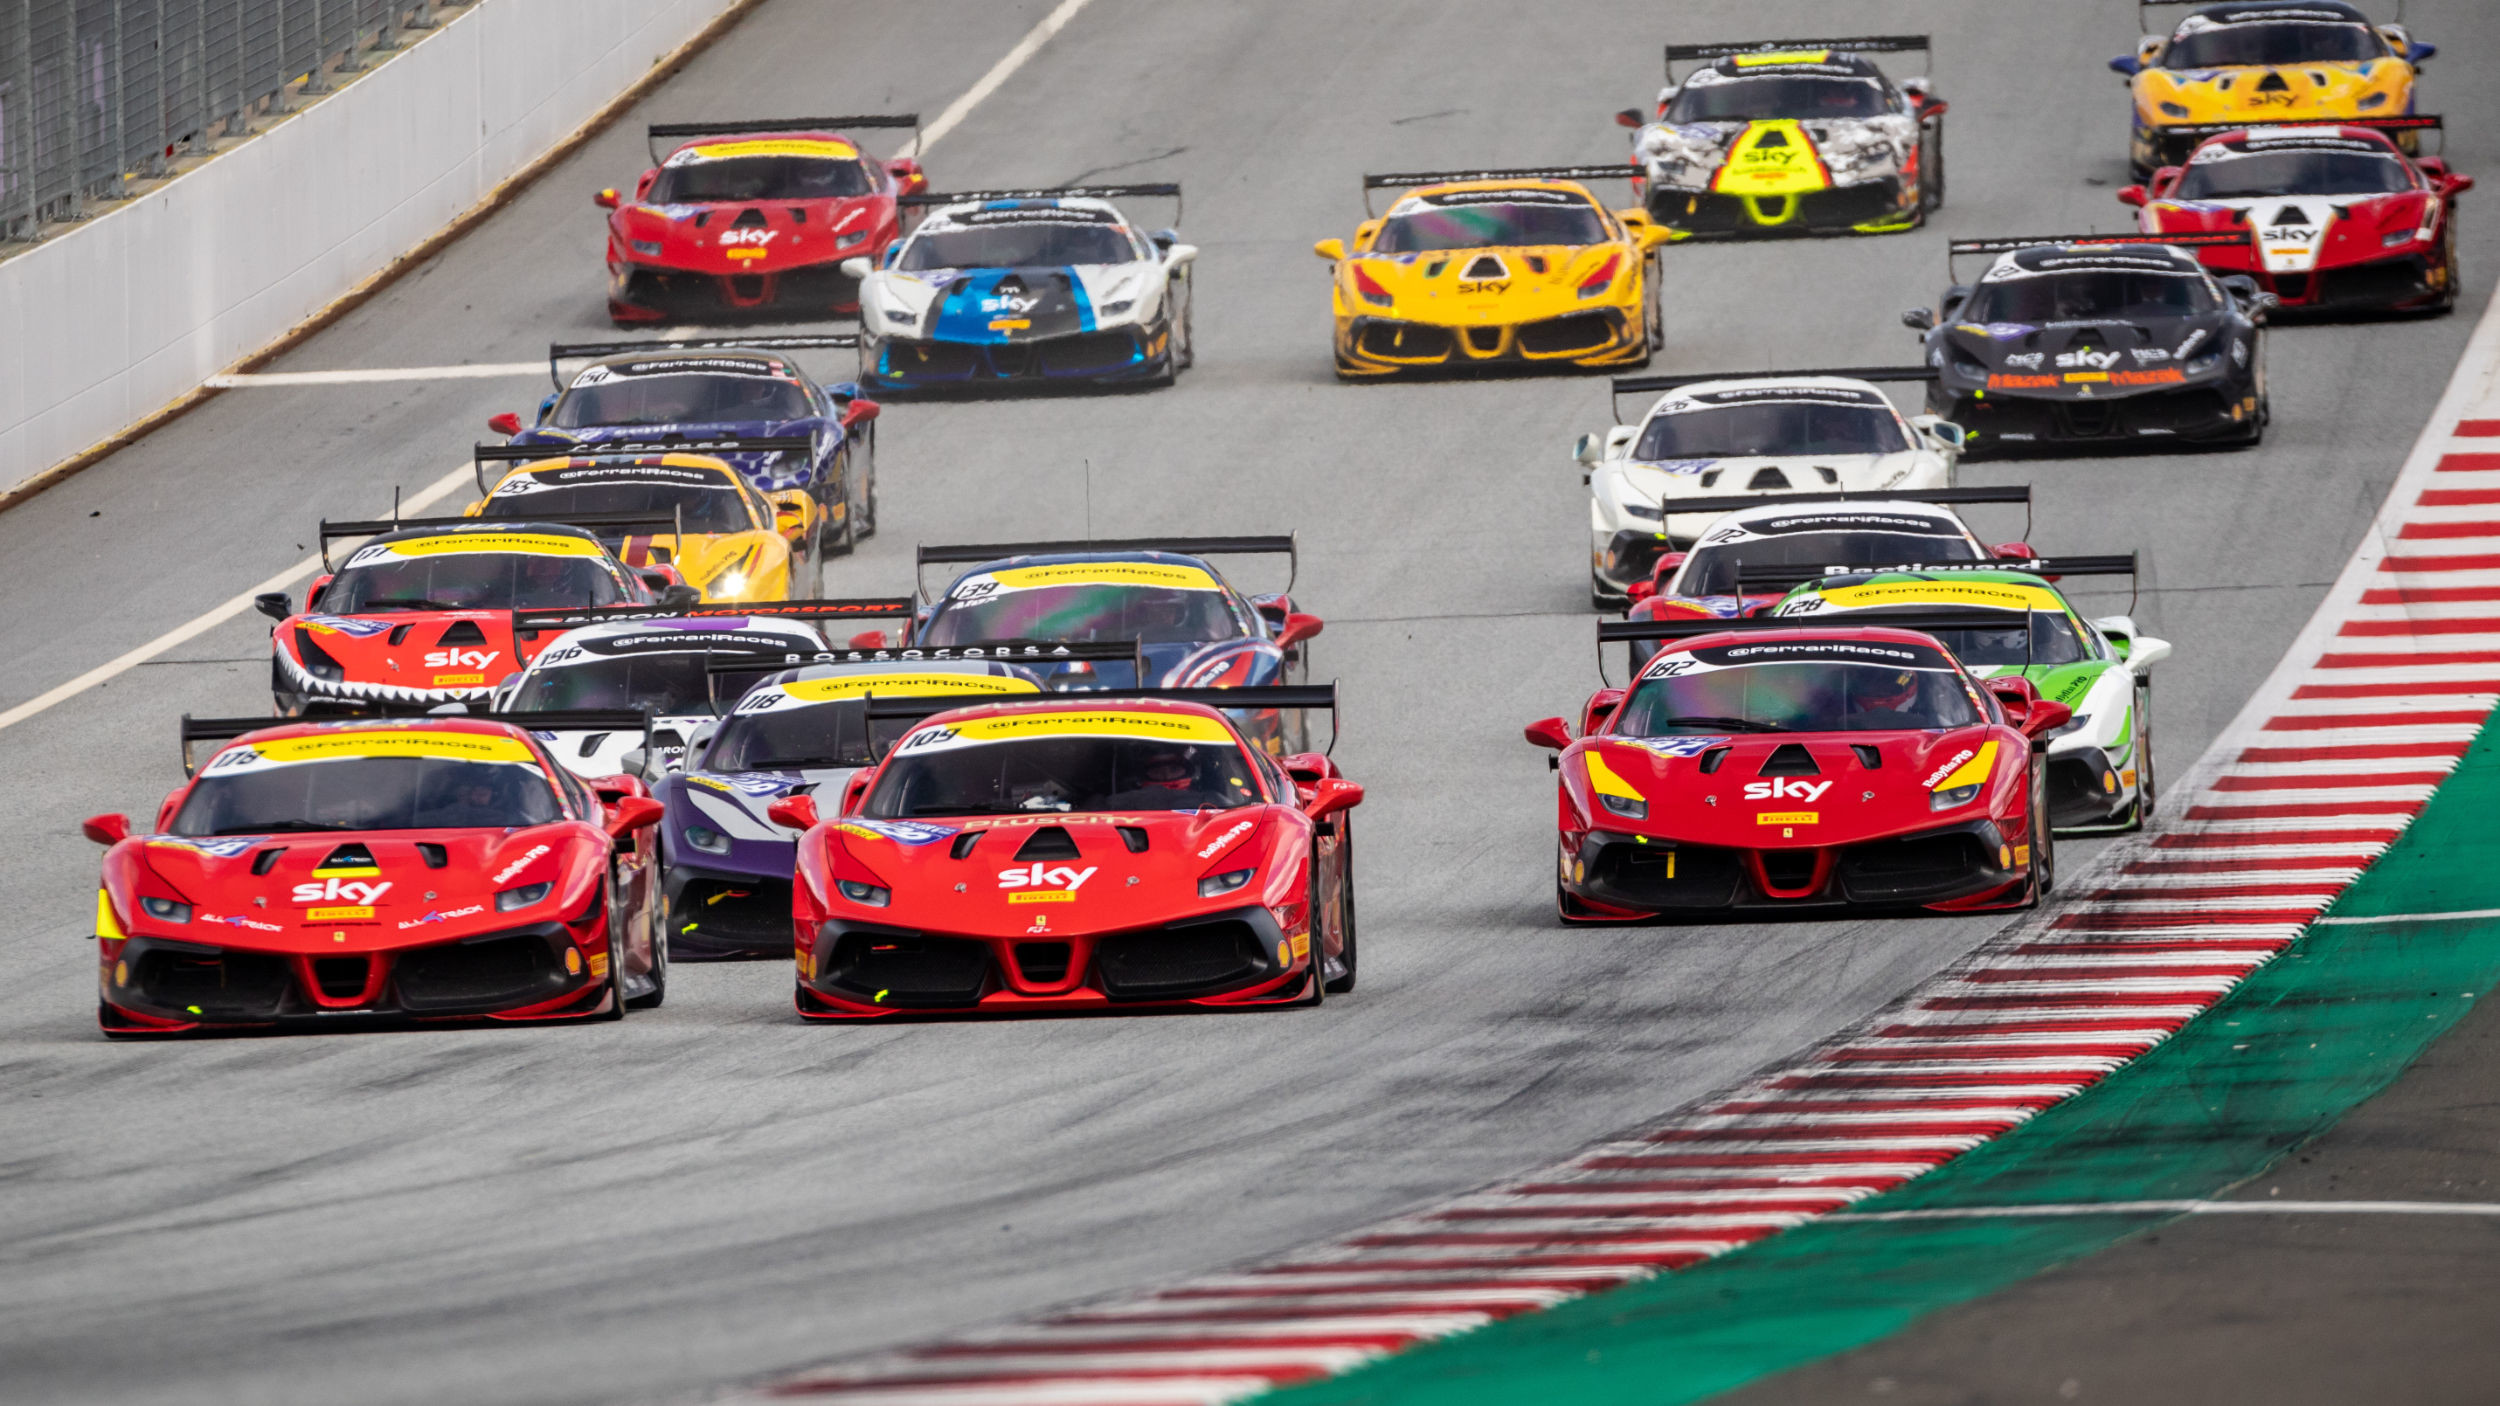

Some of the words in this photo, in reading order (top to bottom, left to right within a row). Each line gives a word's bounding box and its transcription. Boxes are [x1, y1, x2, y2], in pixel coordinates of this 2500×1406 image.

[2250, 92, 2299, 107] sky
[1744, 149, 1798, 164] sky
[719, 227, 779, 245] sky
[2263, 228, 2319, 242] sky
[1458, 281, 1512, 295] sky
[981, 294, 1039, 312] sky
[2055, 350, 2121, 369] sky
[497, 480, 538, 494] 155
[564, 611, 678, 623] BARON
[684, 603, 903, 618] MOTORSPORT
[424, 648, 500, 670] sky
[539, 647, 583, 666] 196
[612, 634, 787, 648] @FerrariRaces
[1645, 661, 1696, 678] 182
[1727, 645, 1916, 659] @FerrariRaces
[740, 694, 785, 711] 118
[904, 727, 963, 750] 109
[987, 717, 1191, 730] @FerrariRaces
[1743, 777, 1833, 802] sky
[998, 862, 1098, 891] sky
[292, 878, 393, 905] sky
